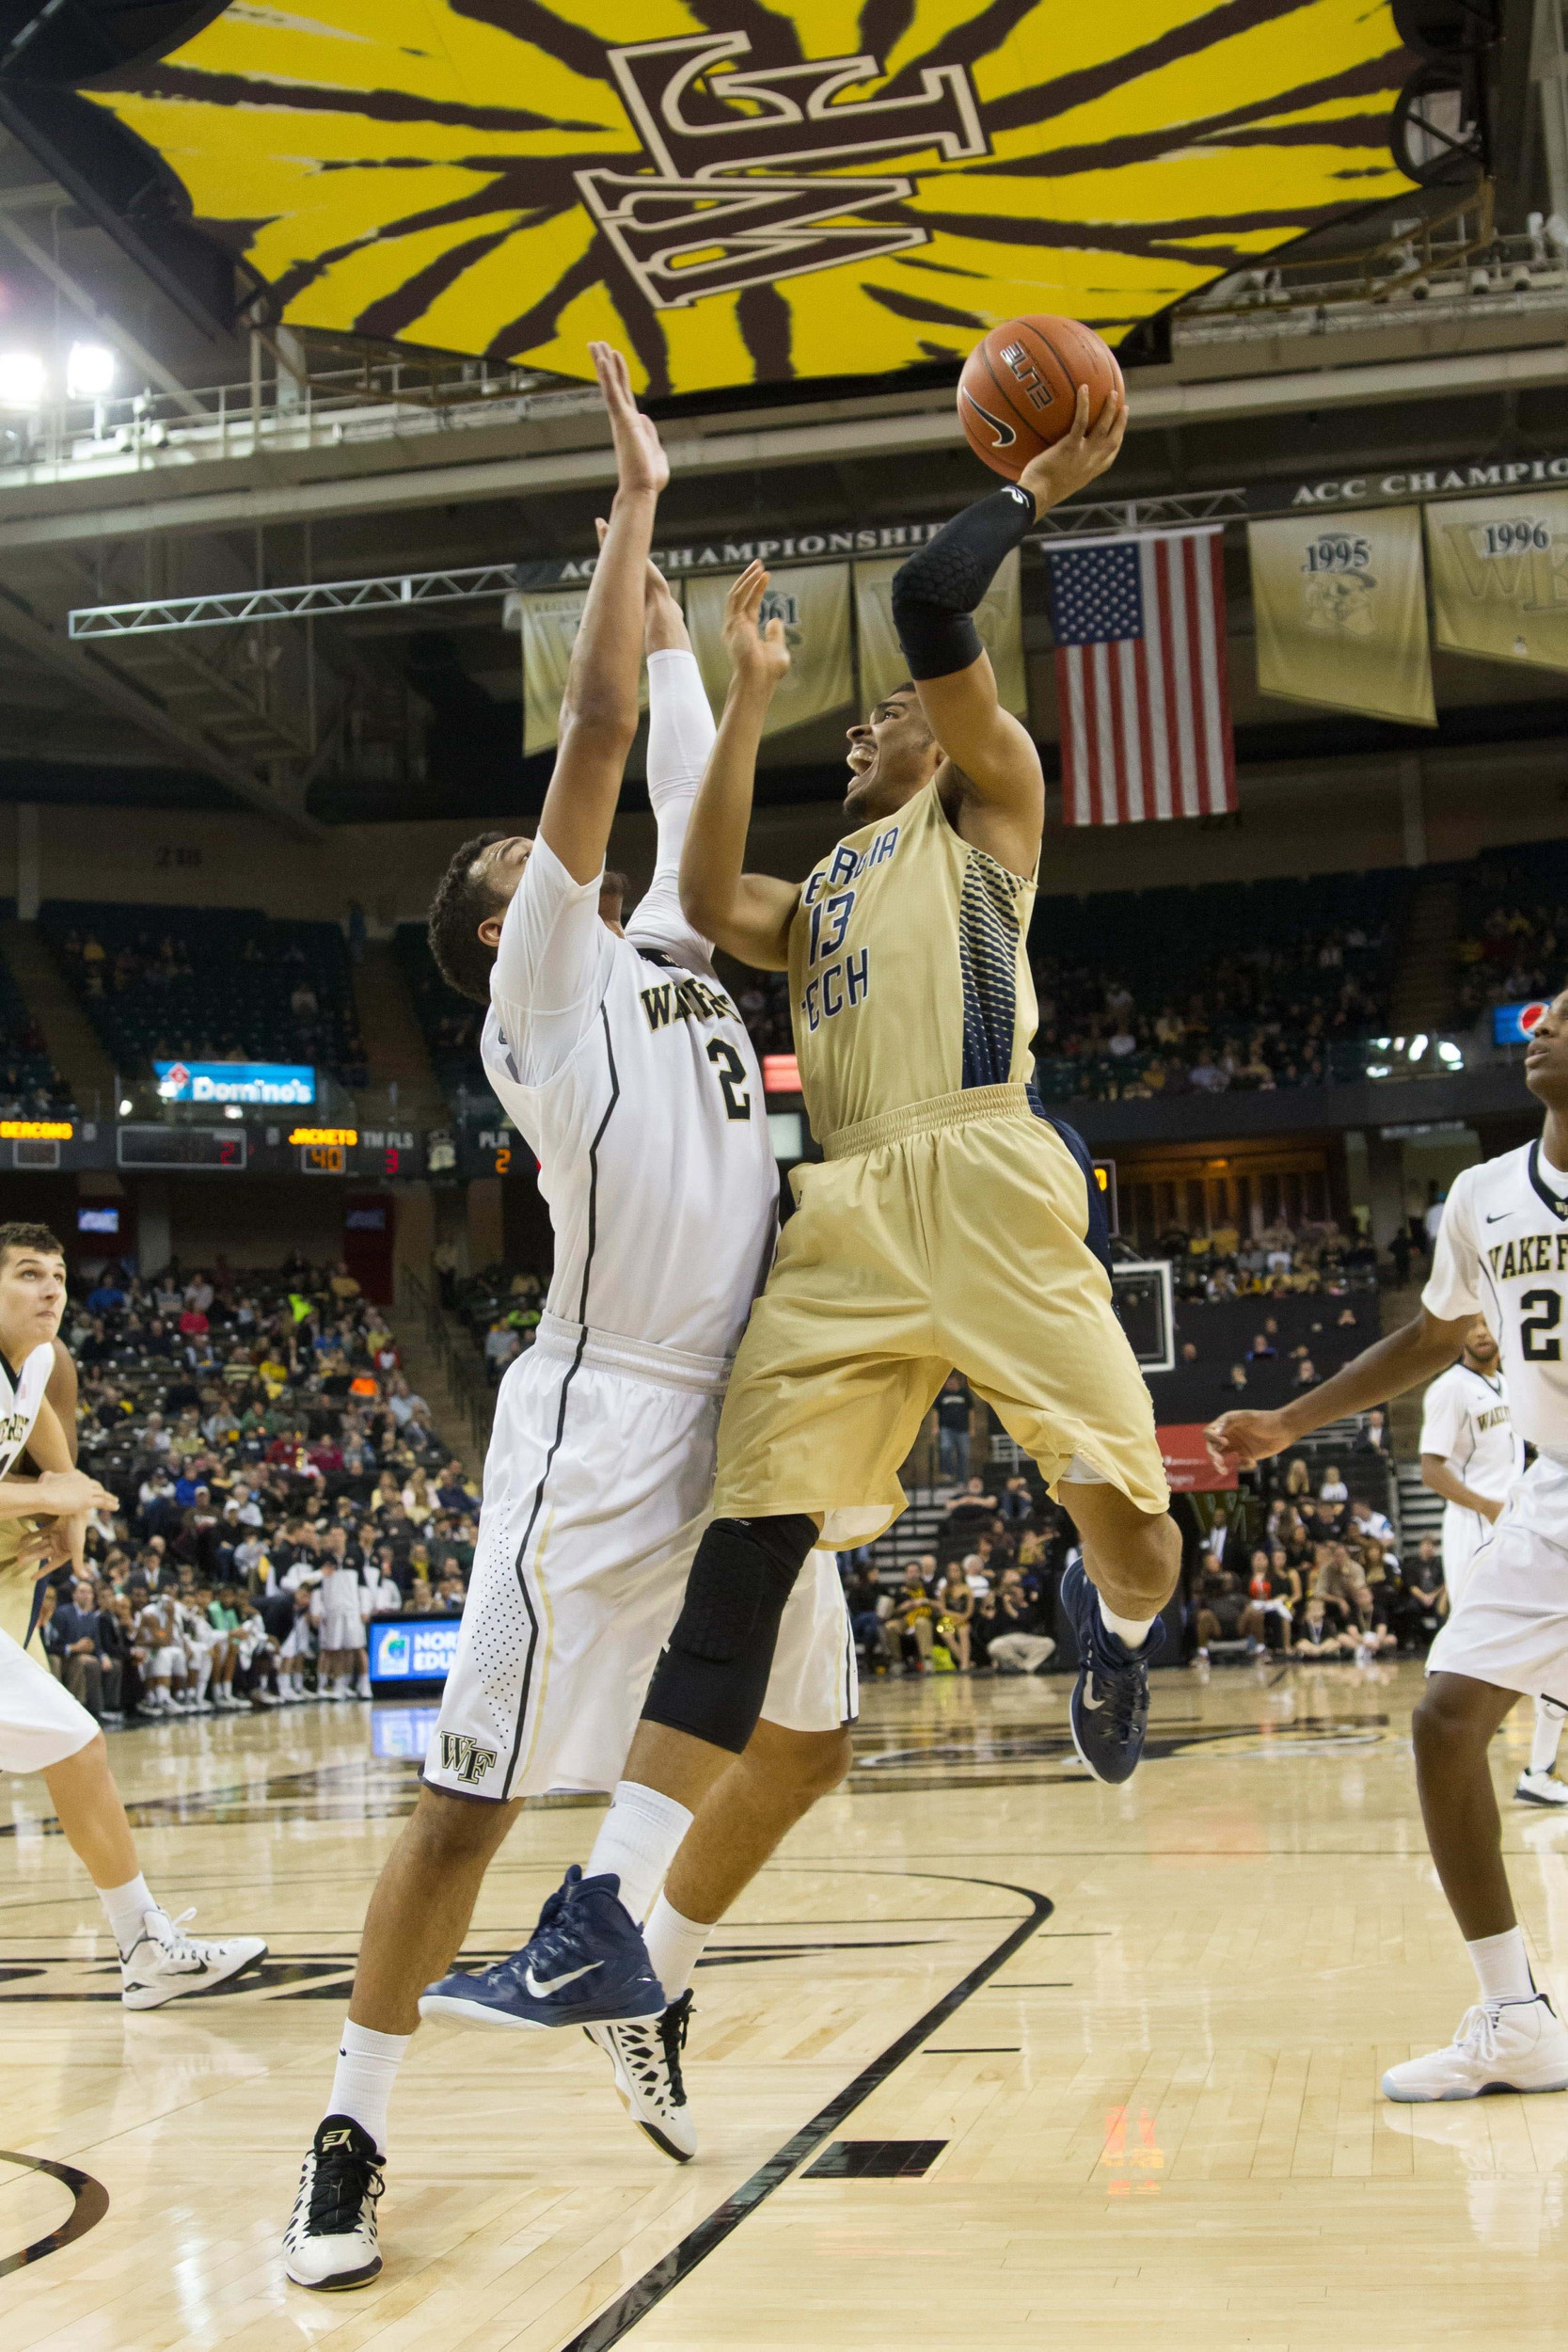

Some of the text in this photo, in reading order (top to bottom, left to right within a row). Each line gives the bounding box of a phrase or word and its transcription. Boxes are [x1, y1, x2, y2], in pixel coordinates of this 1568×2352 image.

[1291, 480, 1367, 505] ACC
[1484, 519, 1550, 556] 1996
[560, 559, 599, 580] AC
[1306, 539, 1370, 572] 1995
[809, 890, 856, 967] 13
[801, 946, 870, 1032] ECH
[192, 1076, 312, 1104] Domino's
[705, 1036, 751, 1121] 2
[289, 1128, 357, 1146] JACKETS
[220, 1140, 235, 1165] 2
[310, 1147, 342, 1170] 40
[385, 1149, 399, 1173] 3
[495, 1149, 512, 1174] 2
[1520, 1289, 1561, 1361] 2
[440, 1730, 497, 1785] WF
